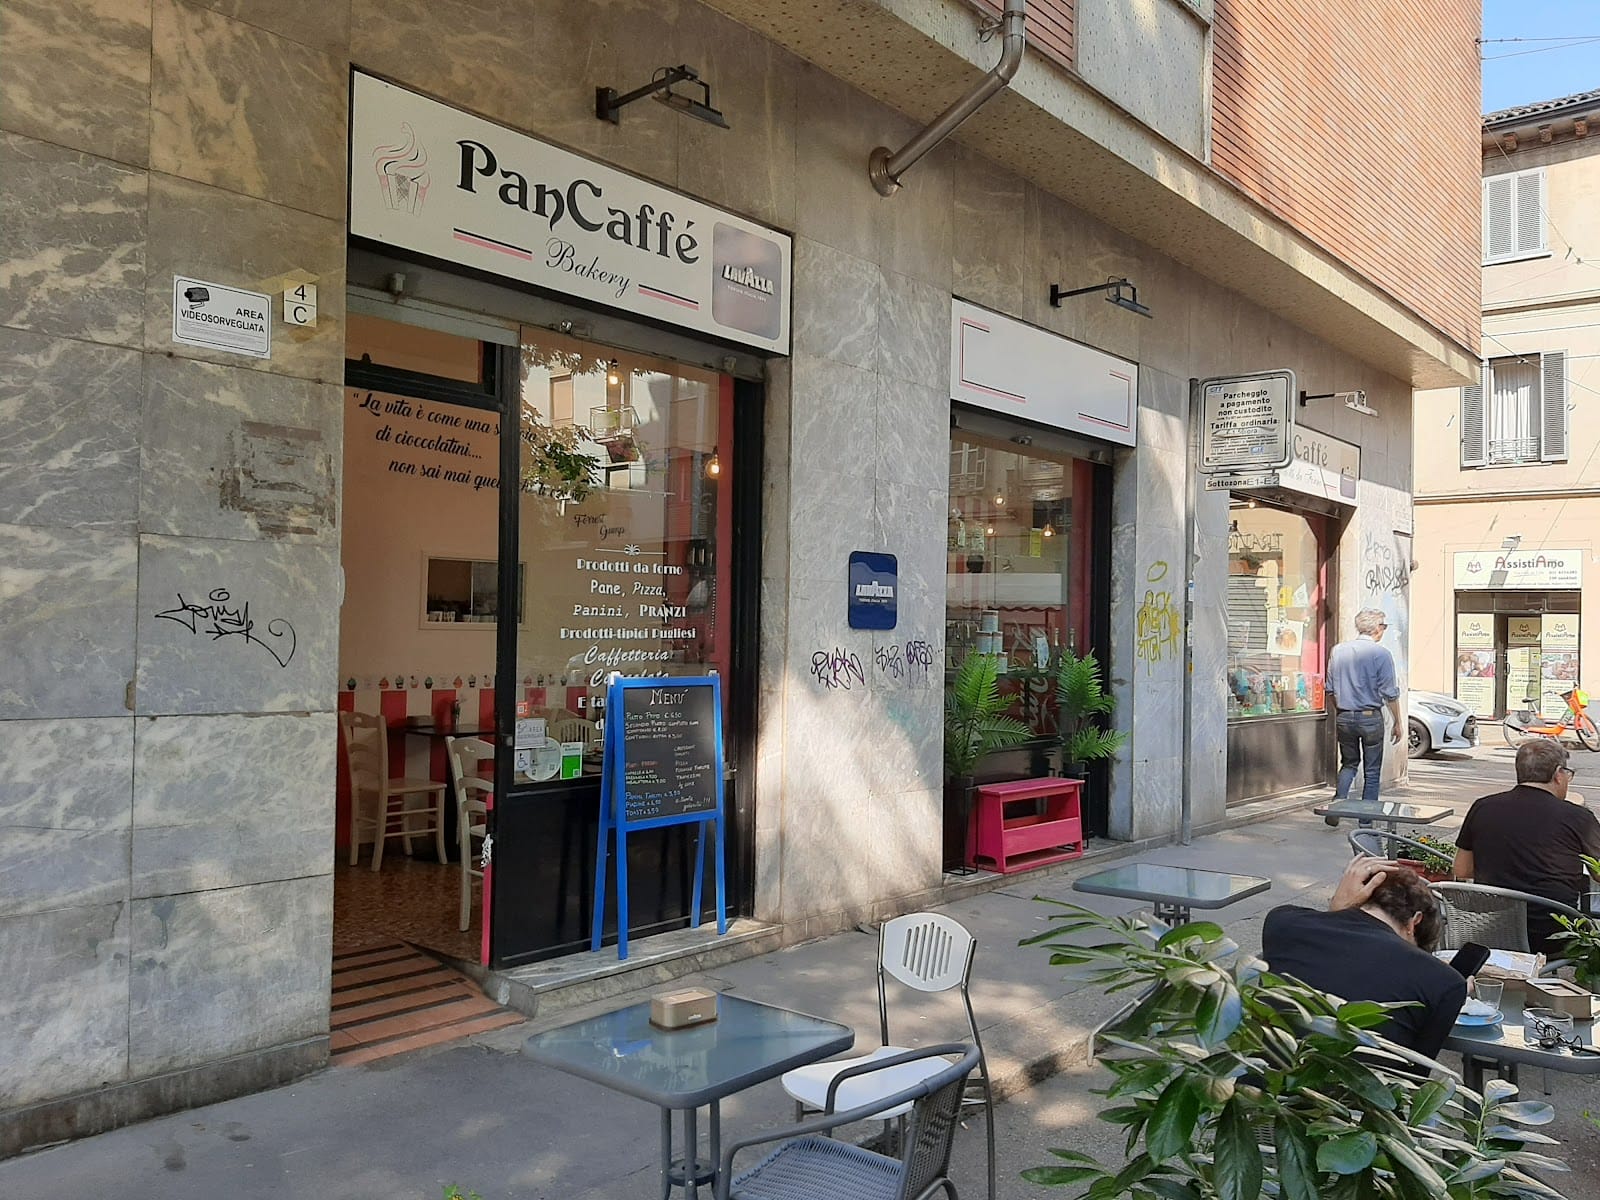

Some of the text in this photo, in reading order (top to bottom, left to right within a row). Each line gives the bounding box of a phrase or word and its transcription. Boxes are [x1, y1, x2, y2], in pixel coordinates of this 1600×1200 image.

[455, 139, 700, 265] PanCaffé
[545, 237, 632, 299] Bakery
[722, 264, 774, 295] LAVAZZA
[294, 285, 307, 300] 4
[180, 309, 264, 333] VIDEOSORVEGLIATA
[235, 308, 264, 321] AREA
[293, 306, 307, 323] C
[1223, 389, 1268, 399] Parcheggio
[1226, 397, 1271, 408] pagamento
[385, 400, 412, 418] vita
[428, 411, 462, 427] come
[465, 419, 491, 434] una
[1234, 405, 1273, 415] custodito
[376, 425, 392, 442] di
[1210, 421, 1237, 430] Tariffa
[389, 460, 416, 476] non
[420, 465, 441, 480] sai
[444, 470, 471, 484] mai
[1207, 477, 1248, 488] Sottozona
[576, 558, 683, 576] Prodotti da forno
[1494, 555, 1564, 569] AssistiAmo
[590, 579, 667, 598] Pane, Pizza,
[573, 604, 630, 619] Panini,
[584, 645, 671, 666] Caffetteria
